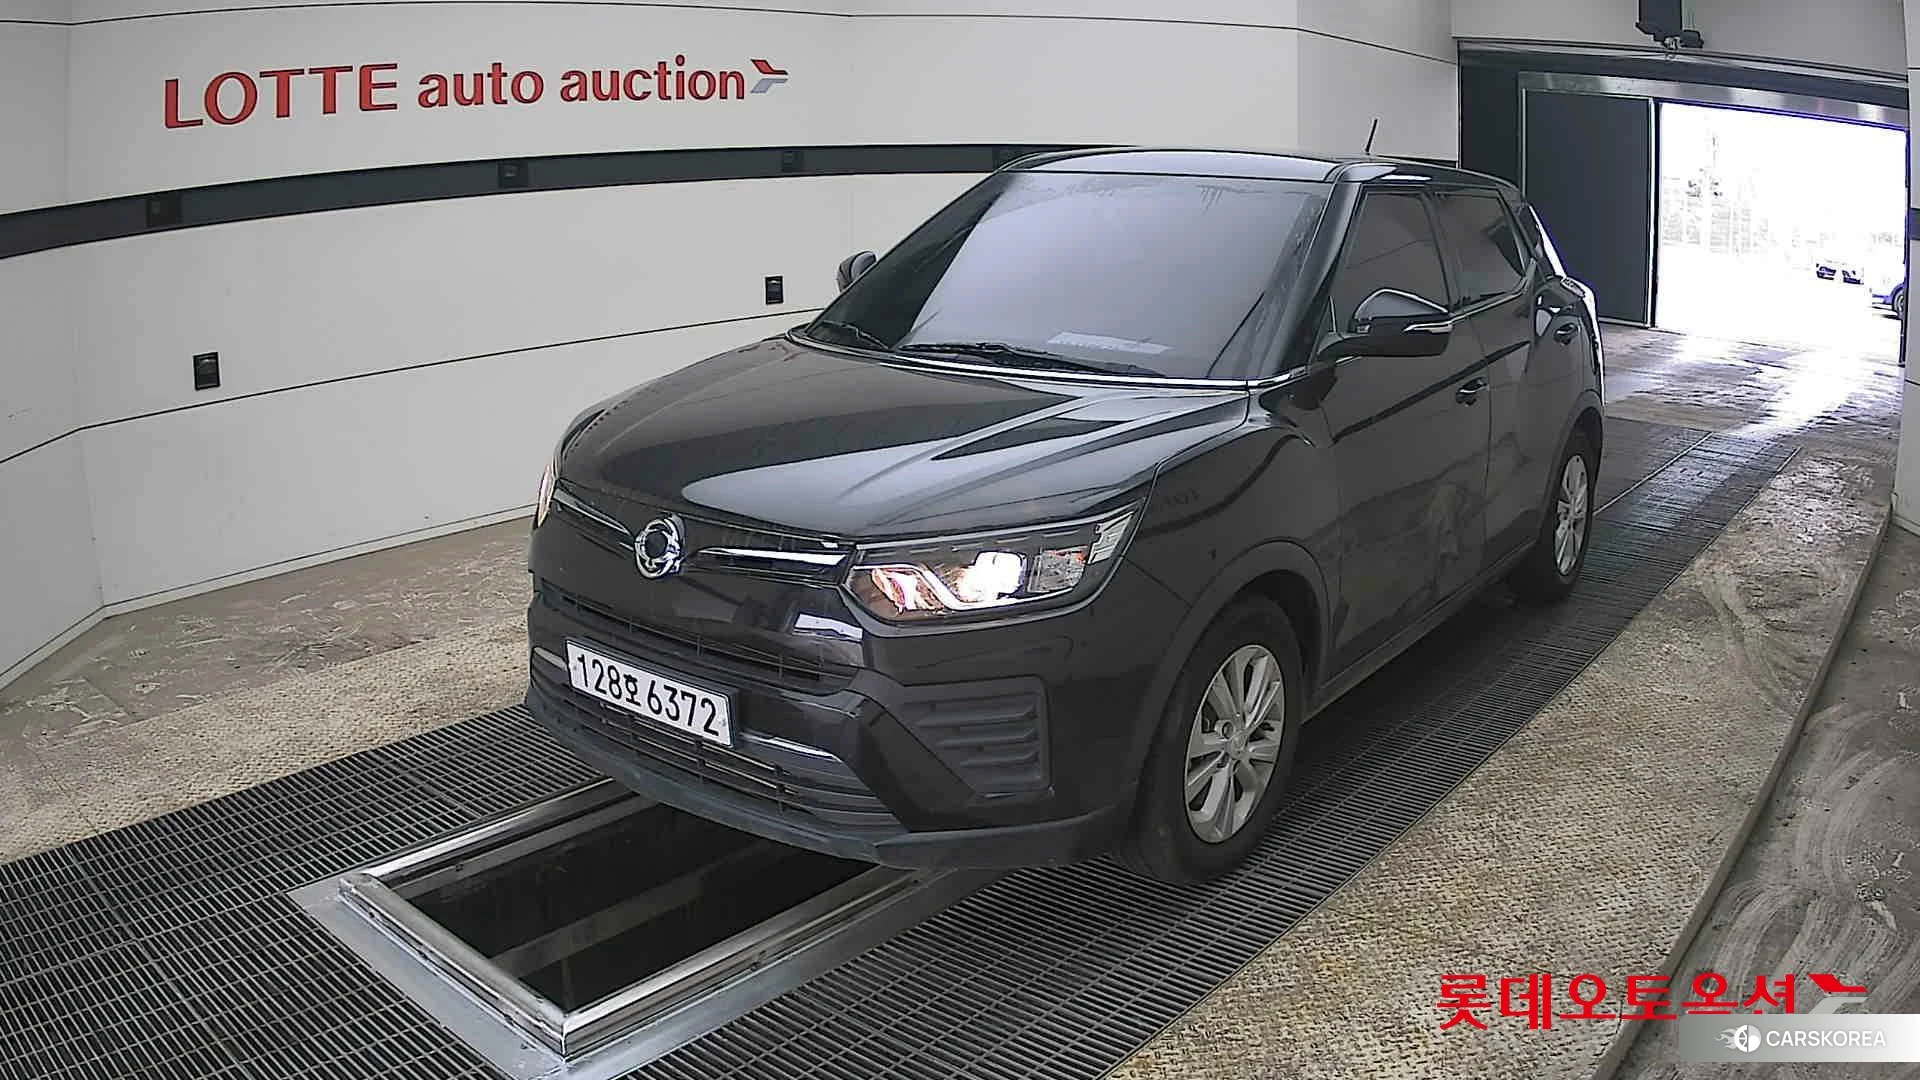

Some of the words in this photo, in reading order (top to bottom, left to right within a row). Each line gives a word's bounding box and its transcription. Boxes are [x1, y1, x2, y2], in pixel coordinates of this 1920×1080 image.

[164, 63, 399, 129] LOTTE
[417, 62, 545, 109] auto
[560, 54, 746, 102] auction
